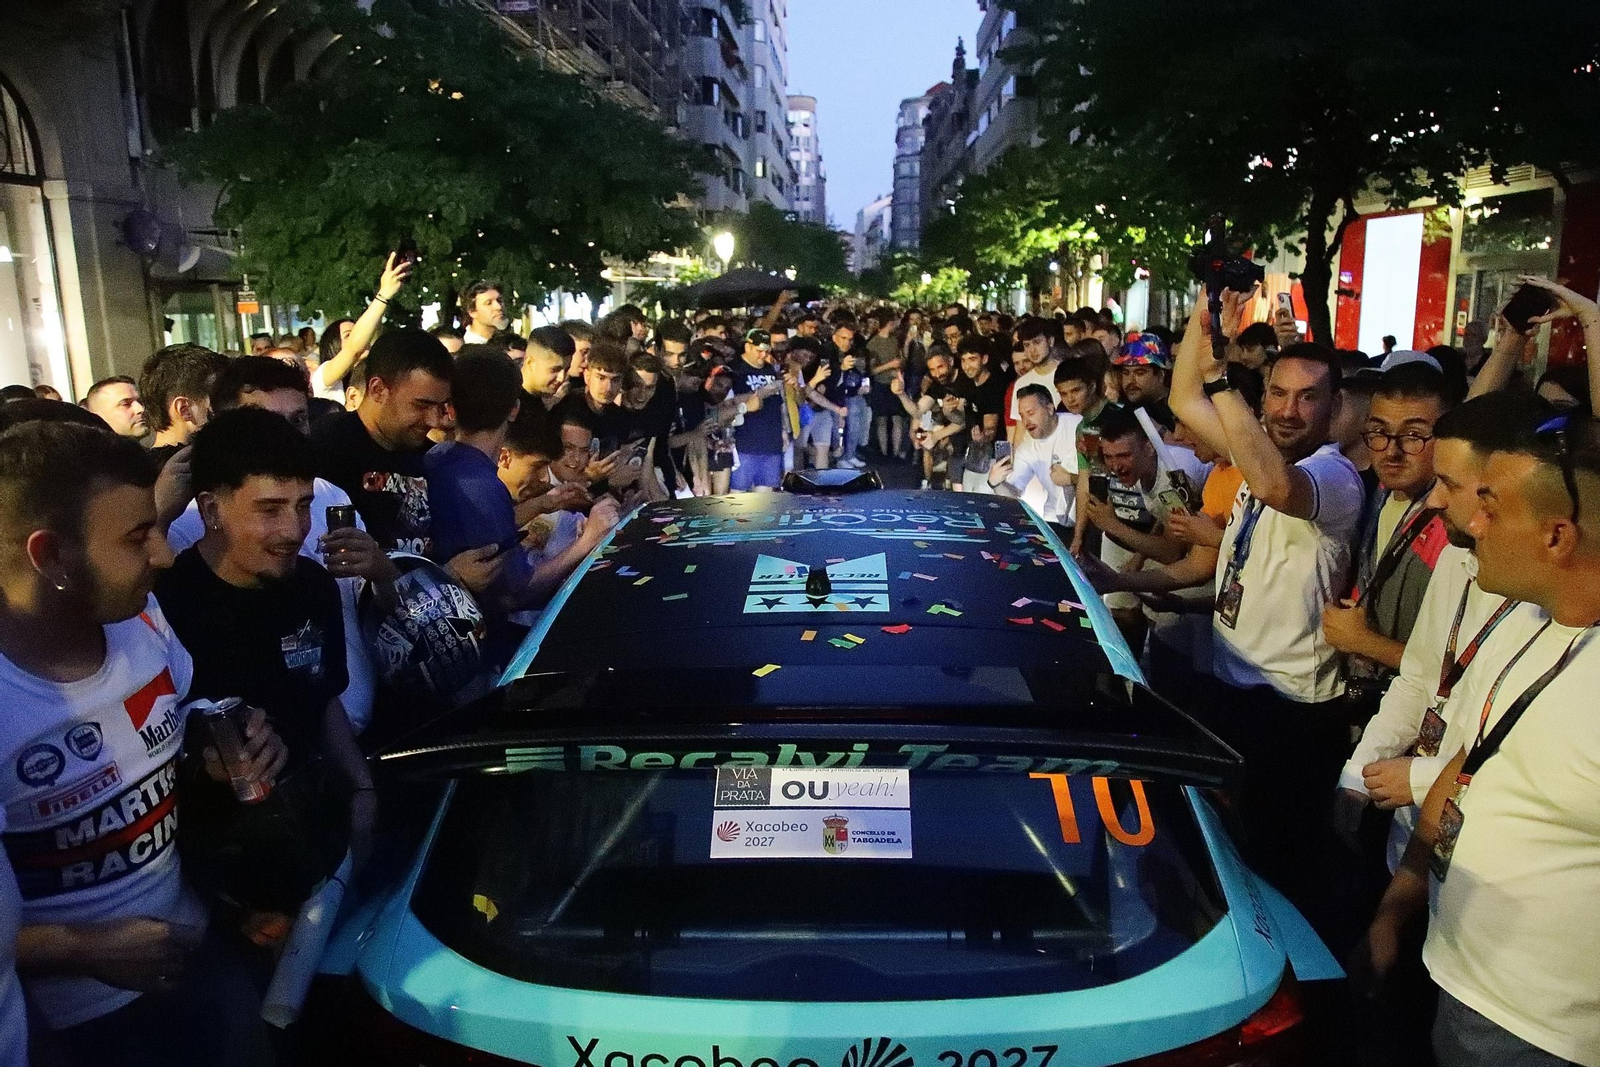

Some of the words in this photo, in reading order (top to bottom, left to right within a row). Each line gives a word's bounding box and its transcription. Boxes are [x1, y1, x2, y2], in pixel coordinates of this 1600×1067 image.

[578, 743, 869, 770] Recalvi
[899, 744, 1119, 775] Team
[720, 790, 766, 801] PRATA
[781, 780, 830, 800] OU
[829, 777, 899, 801] yeah!
[1029, 773, 1155, 846] 10
[745, 821, 809, 832] Xacobeo
[744, 836, 775, 847] 2027
